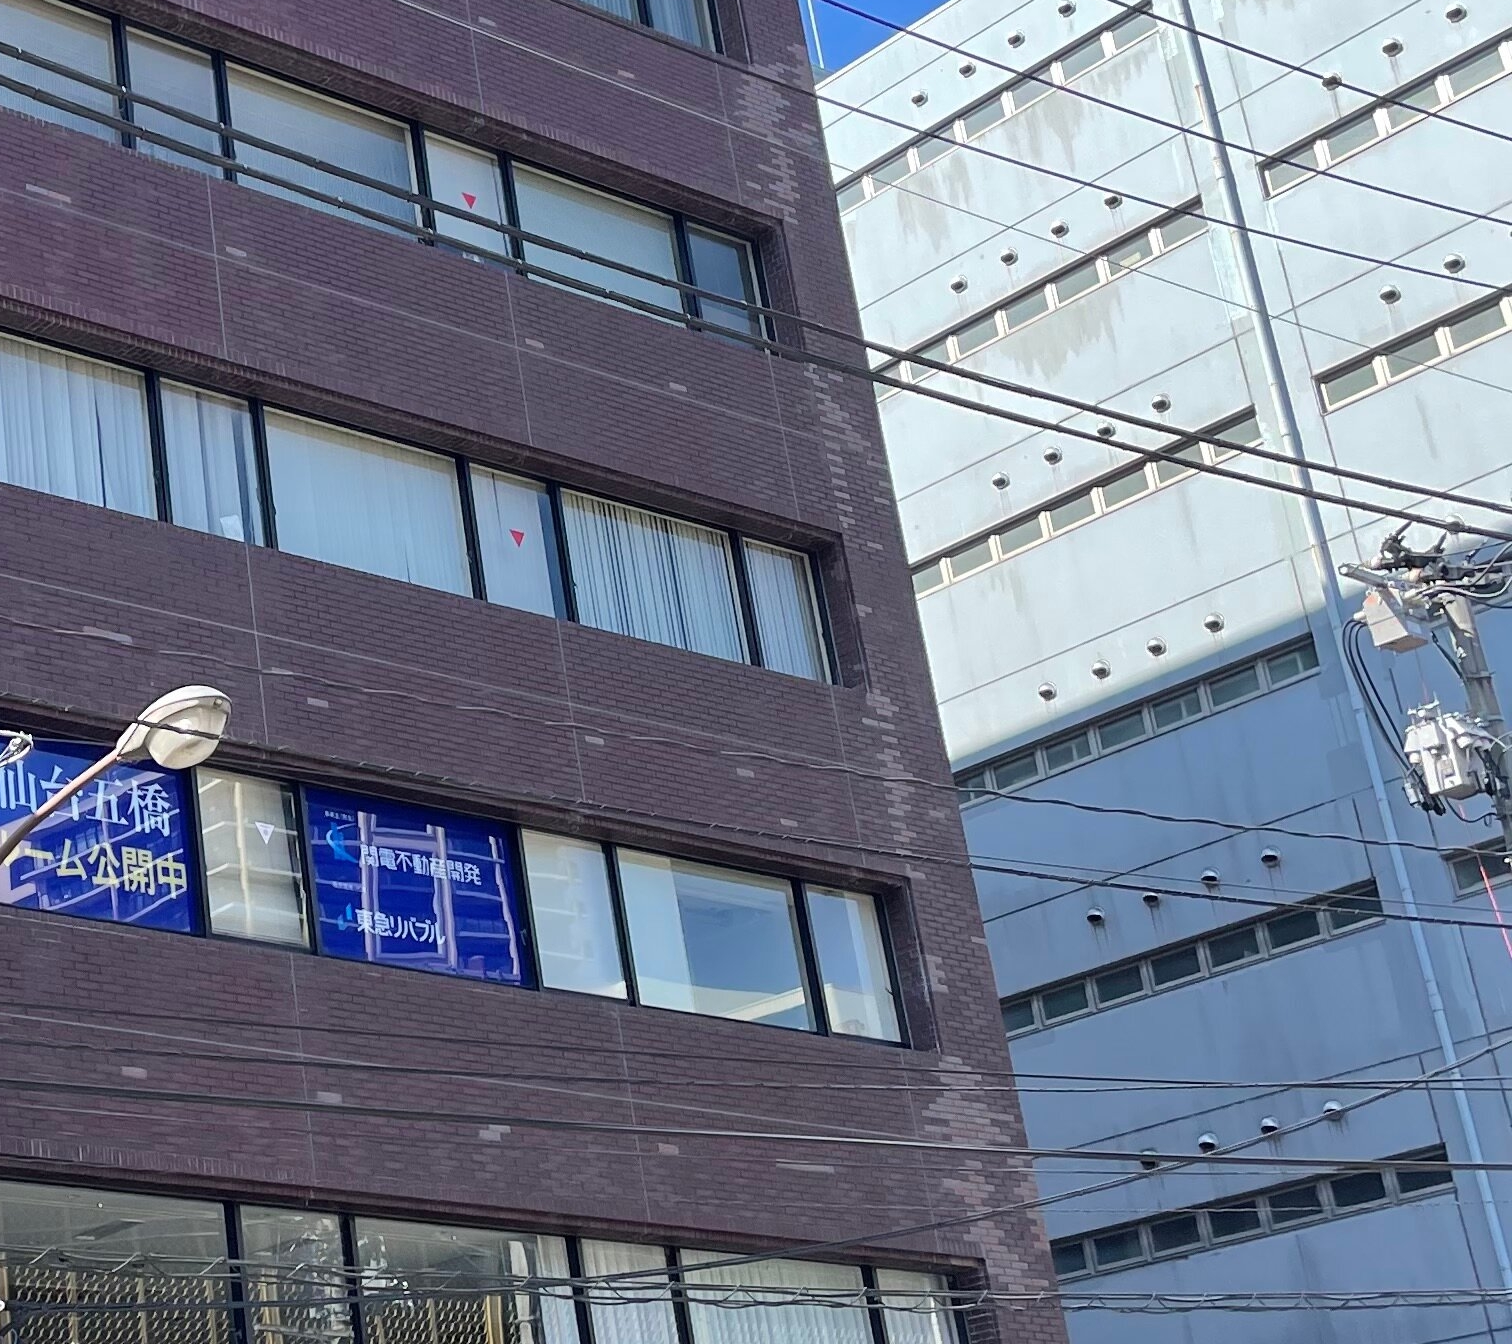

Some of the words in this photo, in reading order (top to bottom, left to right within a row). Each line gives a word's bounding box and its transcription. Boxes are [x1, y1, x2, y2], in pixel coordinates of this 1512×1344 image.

[360, 844, 482, 886] 関電不動産開発
[354, 908, 446, 945] 東急リバブル
